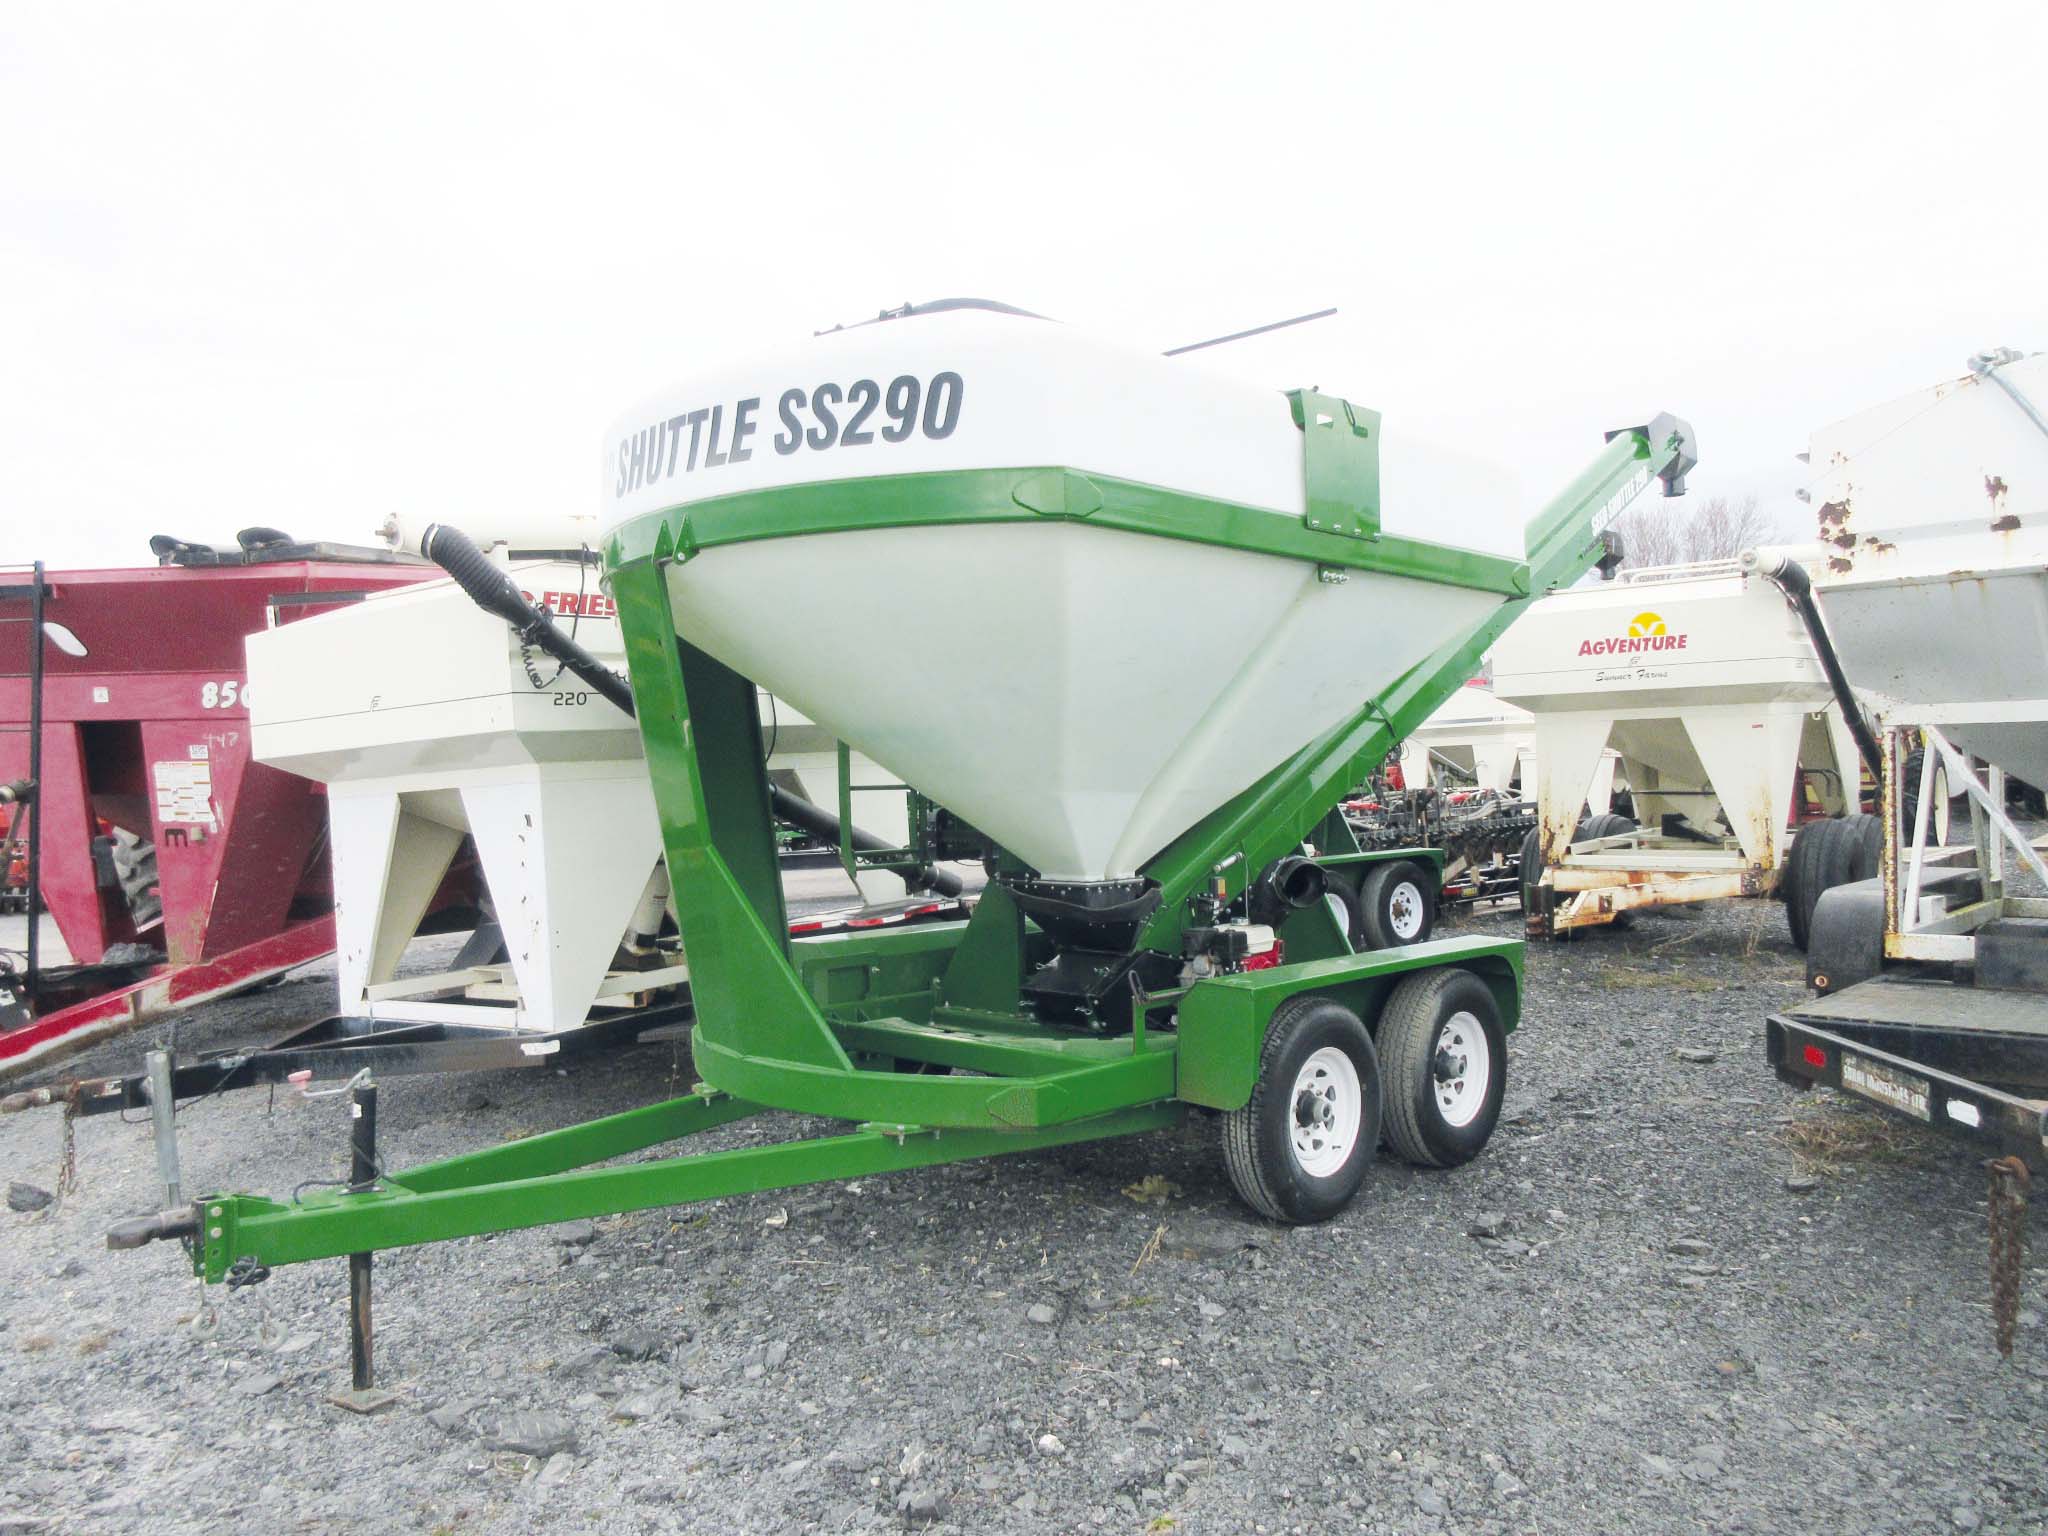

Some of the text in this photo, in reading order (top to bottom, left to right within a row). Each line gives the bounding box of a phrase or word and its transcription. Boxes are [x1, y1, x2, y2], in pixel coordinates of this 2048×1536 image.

[615, 372, 963, 499] SHUTTLE SS290
[1578, 634, 1688, 656] AGVENTURE
[553, 692, 587, 706] 220
